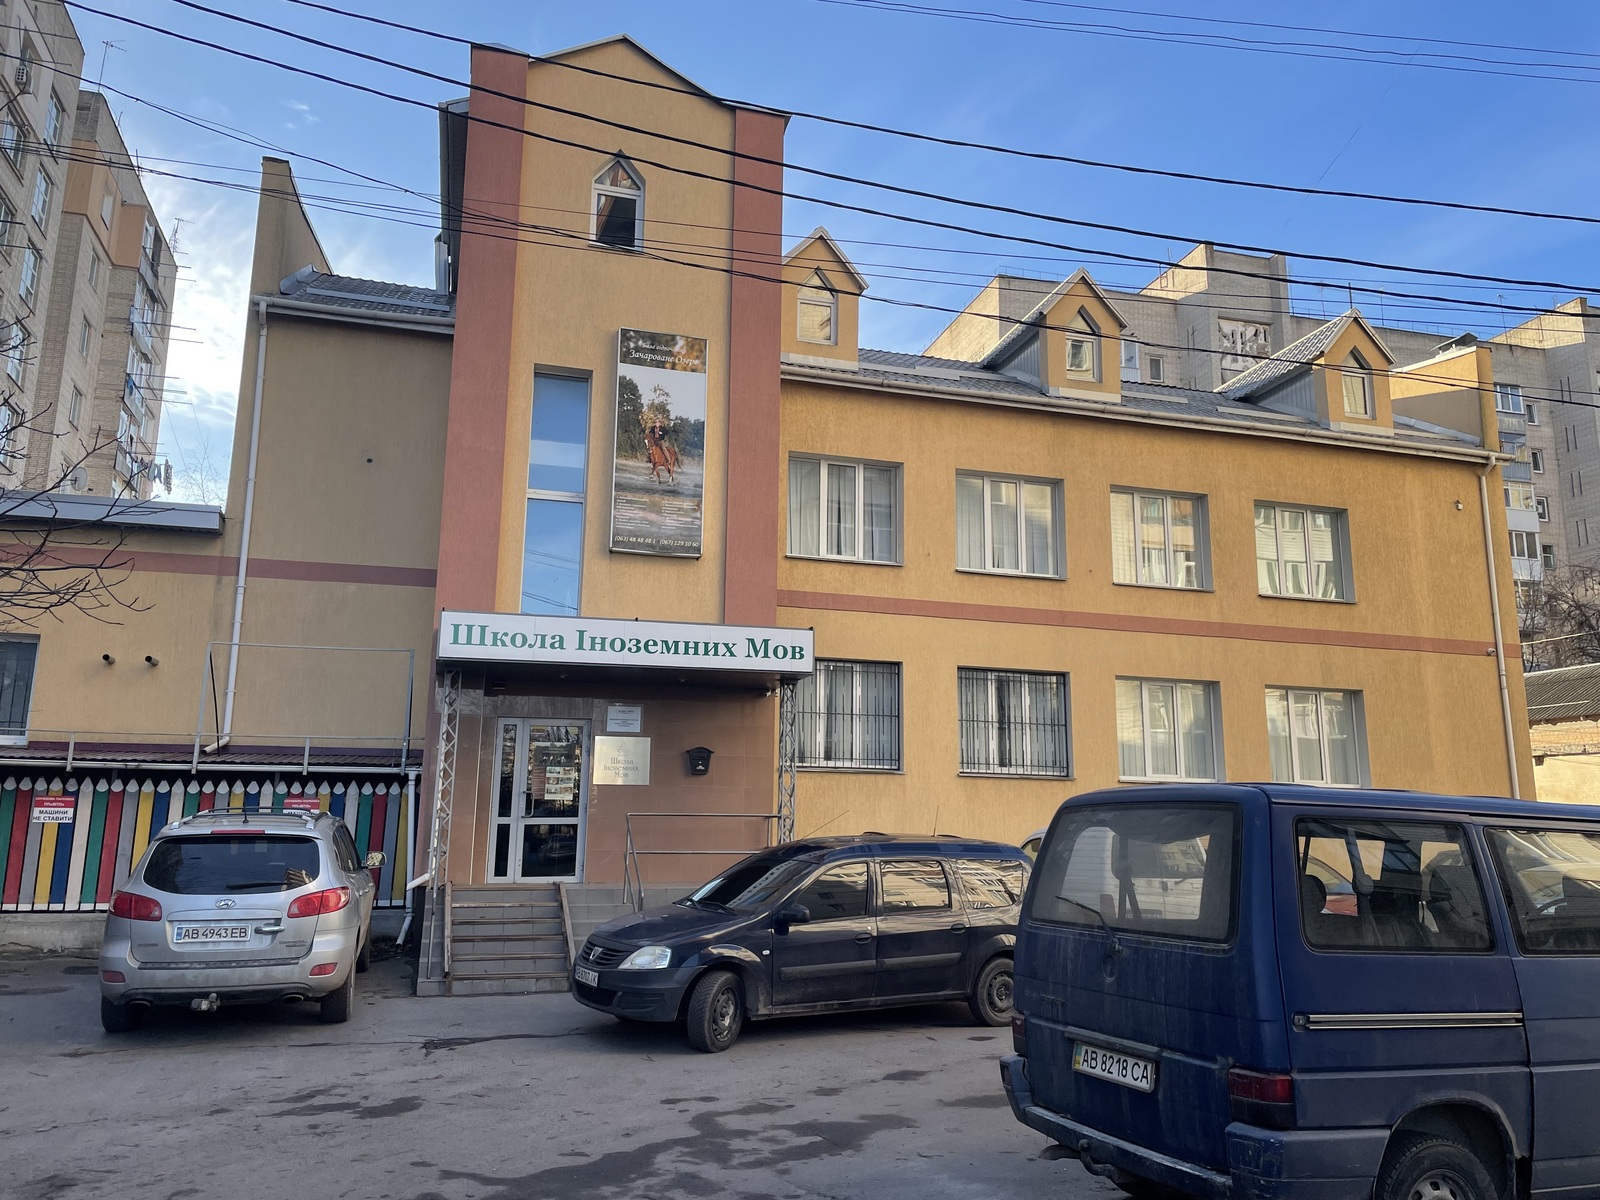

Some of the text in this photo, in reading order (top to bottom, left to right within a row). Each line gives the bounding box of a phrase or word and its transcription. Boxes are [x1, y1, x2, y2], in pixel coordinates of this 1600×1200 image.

[629, 349, 699, 366] Зачароване Озеро
[450, 623, 805, 660] Школа Іноземних Мов
[610, 757, 634, 765] Школа
[182, 927, 247, 940] AB 4943 EB
[1081, 1049, 1149, 1085] AB 8218 CA
